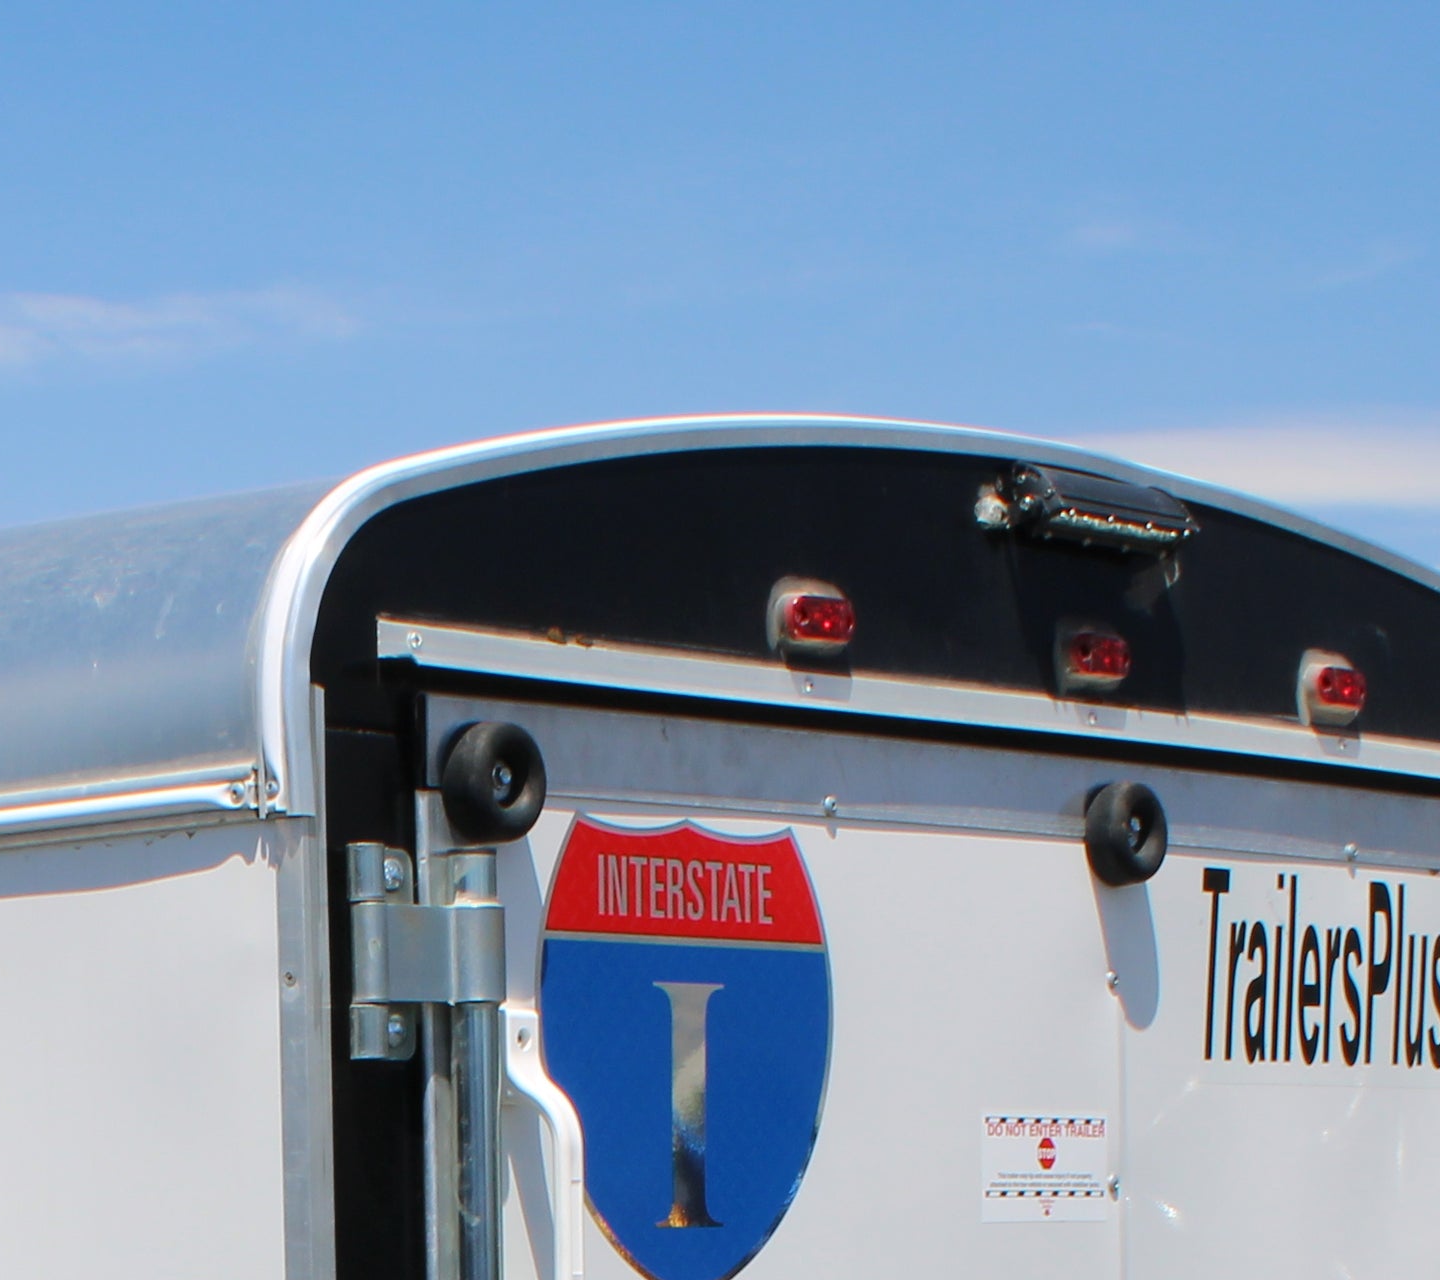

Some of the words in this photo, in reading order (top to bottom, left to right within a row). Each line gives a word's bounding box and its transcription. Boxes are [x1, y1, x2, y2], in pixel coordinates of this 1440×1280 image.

[598, 853, 773, 925] INTERSTATE
[987, 1123, 1003, 1136] DO
[1005, 1123, 1026, 1136] NOT
[1029, 1123, 1062, 1137] ENTER
[1065, 1124, 1105, 1138] TRAILER
